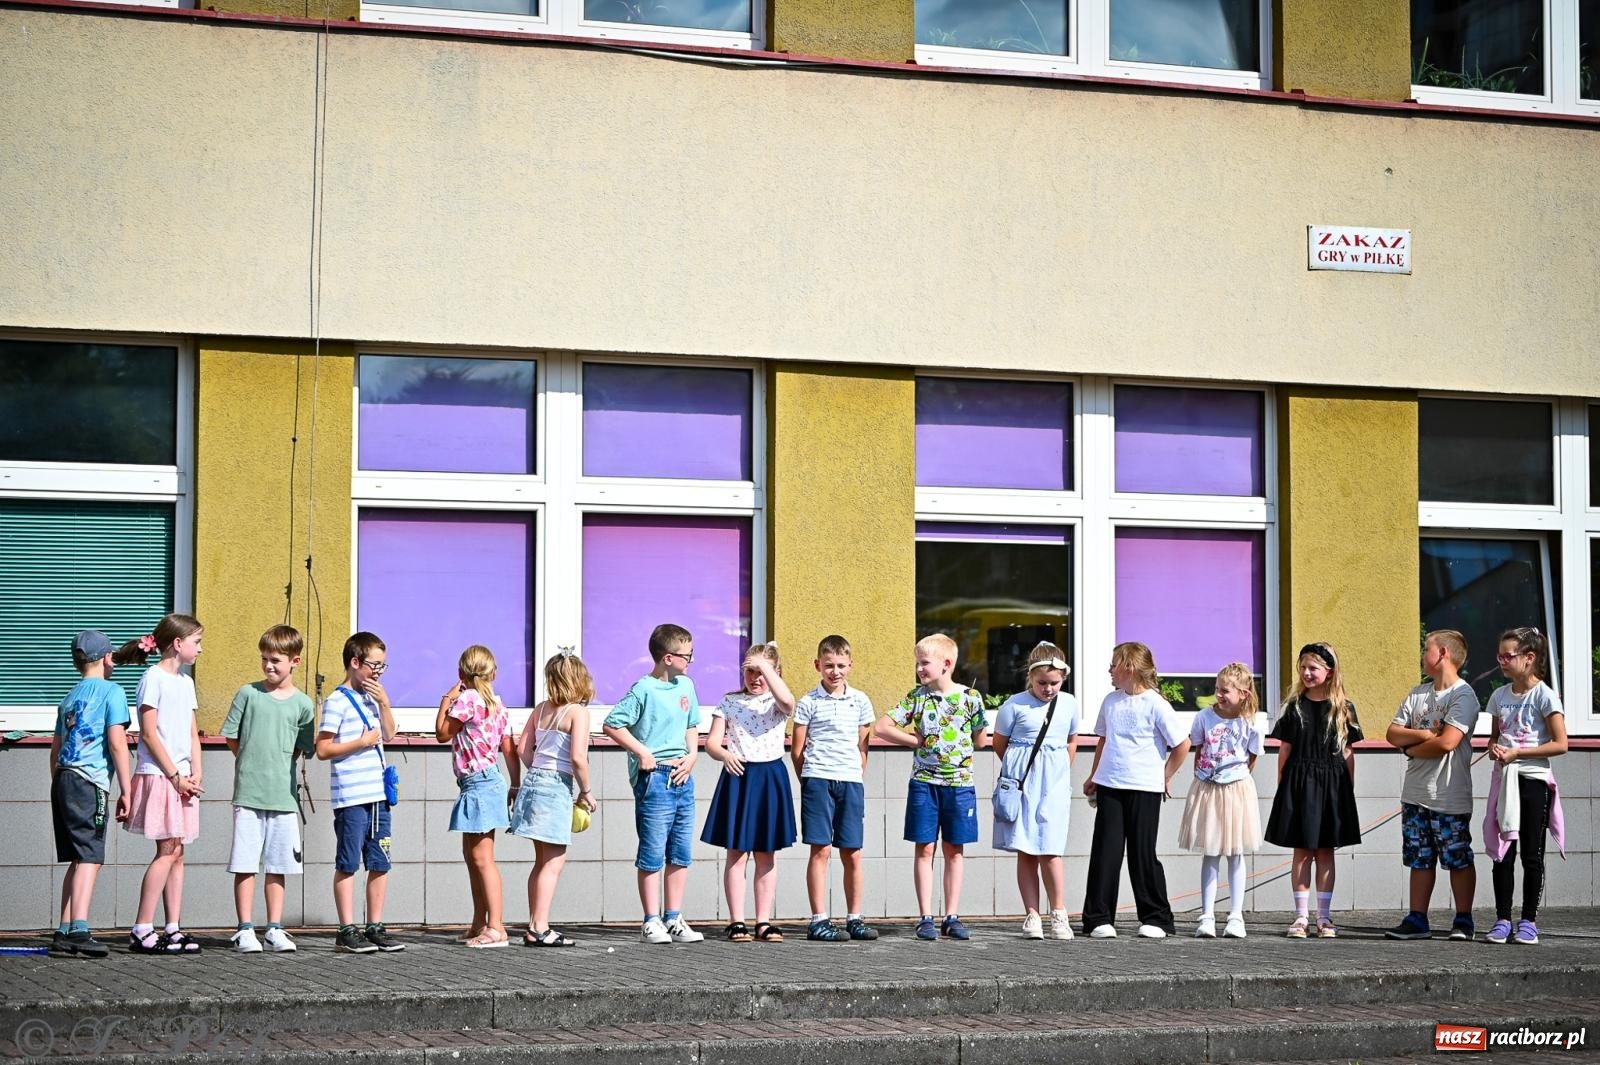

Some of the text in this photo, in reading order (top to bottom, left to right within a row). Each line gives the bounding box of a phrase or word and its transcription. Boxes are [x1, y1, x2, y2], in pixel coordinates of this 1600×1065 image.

[1318, 232, 1405, 249] ZAKAZ
[1318, 250, 1347, 262] GRY
[1364, 252, 1405, 267] PIŁKĘ
